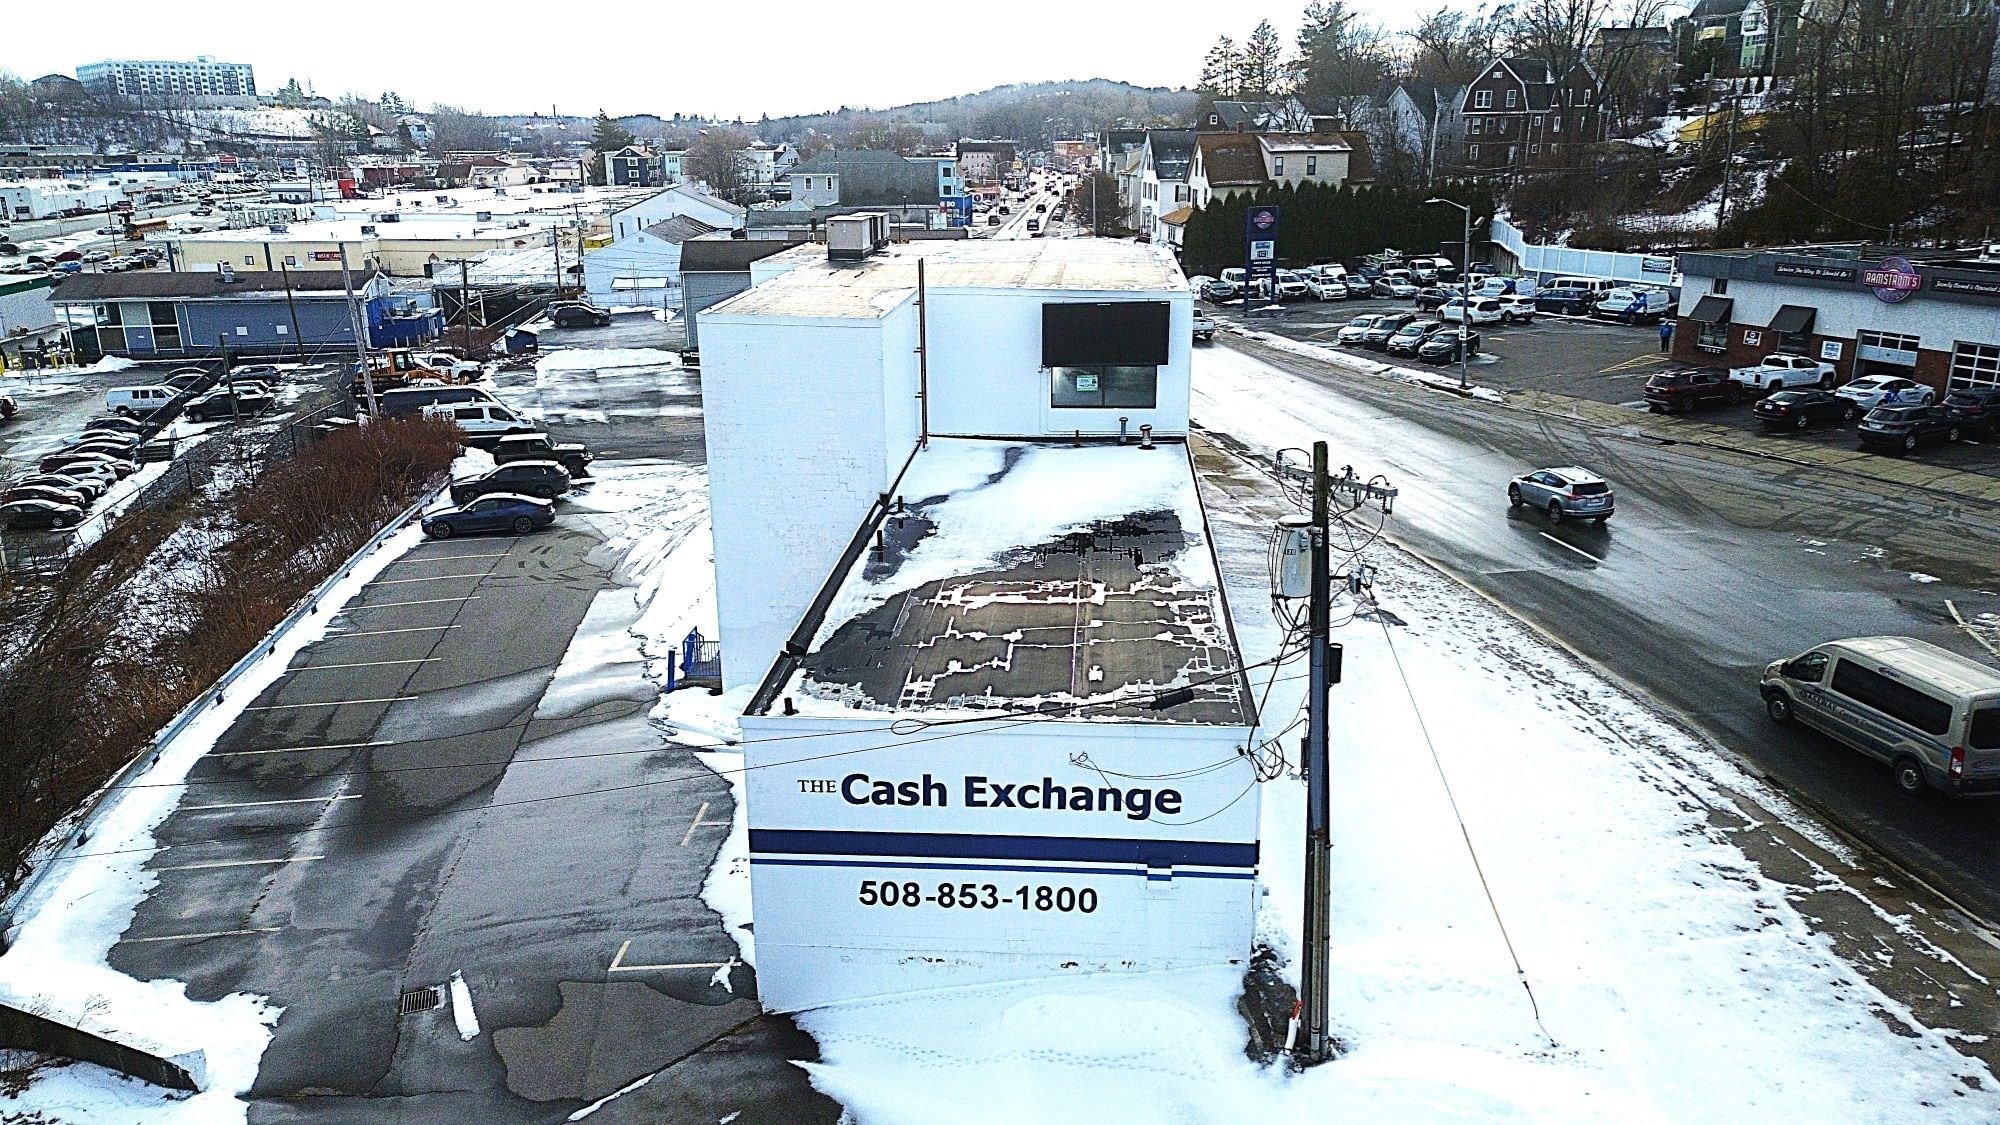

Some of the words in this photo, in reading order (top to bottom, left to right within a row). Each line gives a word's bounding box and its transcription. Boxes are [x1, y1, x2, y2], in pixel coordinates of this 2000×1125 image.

[1822, 269, 1840, 277] Should
[1934, 280, 1953, 289] Family
[1974, 284, 1998, 292] Operated
[1613, 293, 1634, 301] Spectrum
[432, 410, 453, 419] OTIS
[797, 779, 837, 793] THE
[841, 773, 947, 807] Cash
[964, 776, 1183, 820] Exchange
[858, 880, 1098, 913] 508-853-1800
